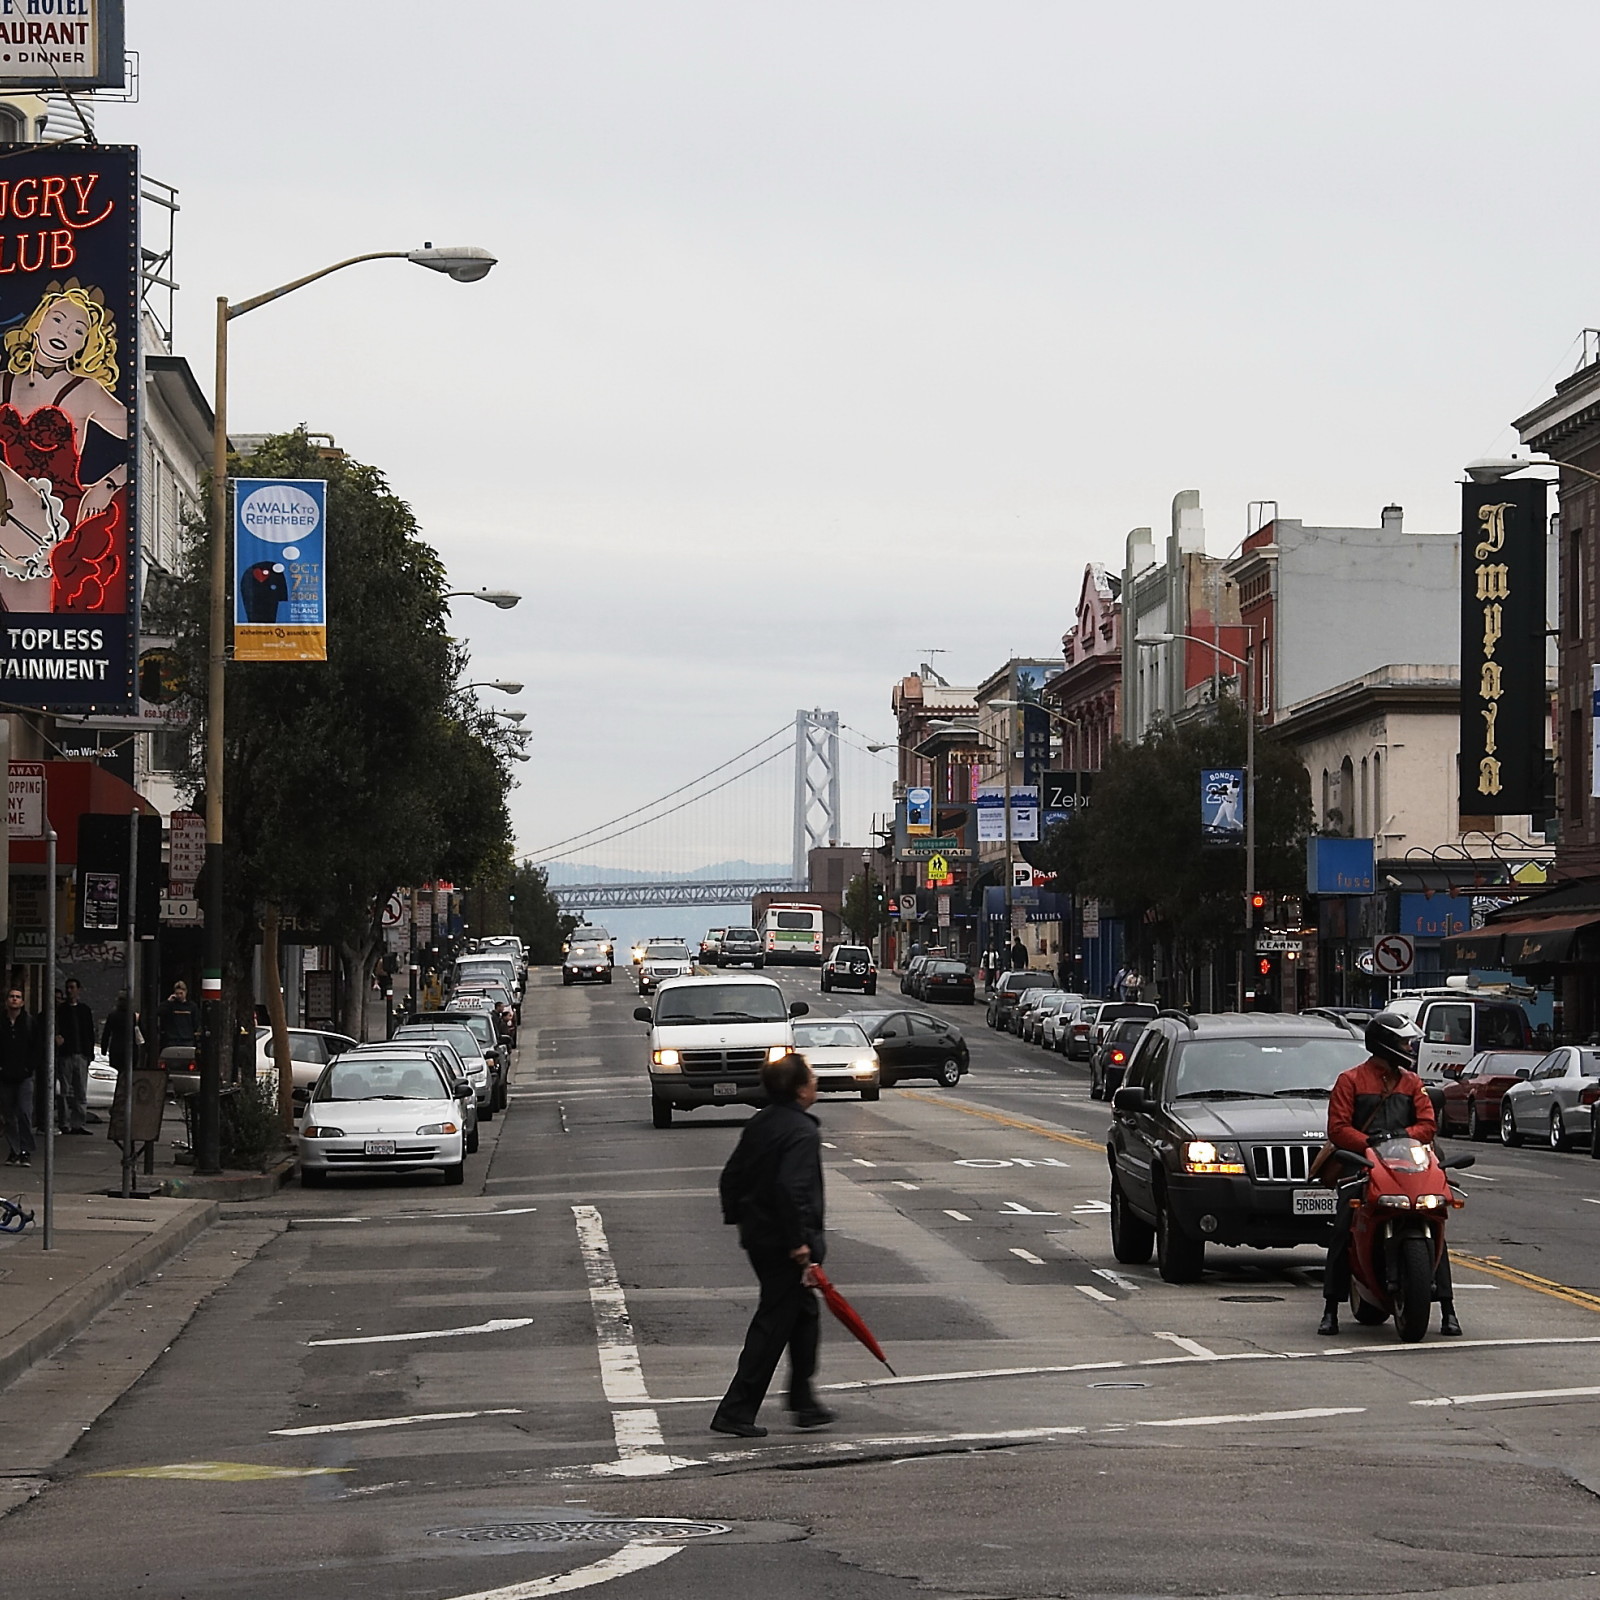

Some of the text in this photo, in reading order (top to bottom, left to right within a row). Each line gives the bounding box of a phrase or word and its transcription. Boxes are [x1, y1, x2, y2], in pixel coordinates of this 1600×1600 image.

[26, 0, 89, 15] HOTEL
[18, 52, 85, 63] DINNER
[247, 502, 314, 515] A WALK TO
[246, 513, 315, 526] REMEMBER
[289, 562, 320, 574] OCT
[7, 628, 104, 651] TOPLESS
[9, 766, 40, 776] AWAY
[1209, 772, 1235, 782] BONDS
[8, 781, 41, 794] OPPING
[1336, 872, 1371, 889] fuse
[16, 932, 47, 945] ATM
[1302, 1130, 1325, 1139] Jeep
[1296, 1198, 1338, 1212] 5RBN88
